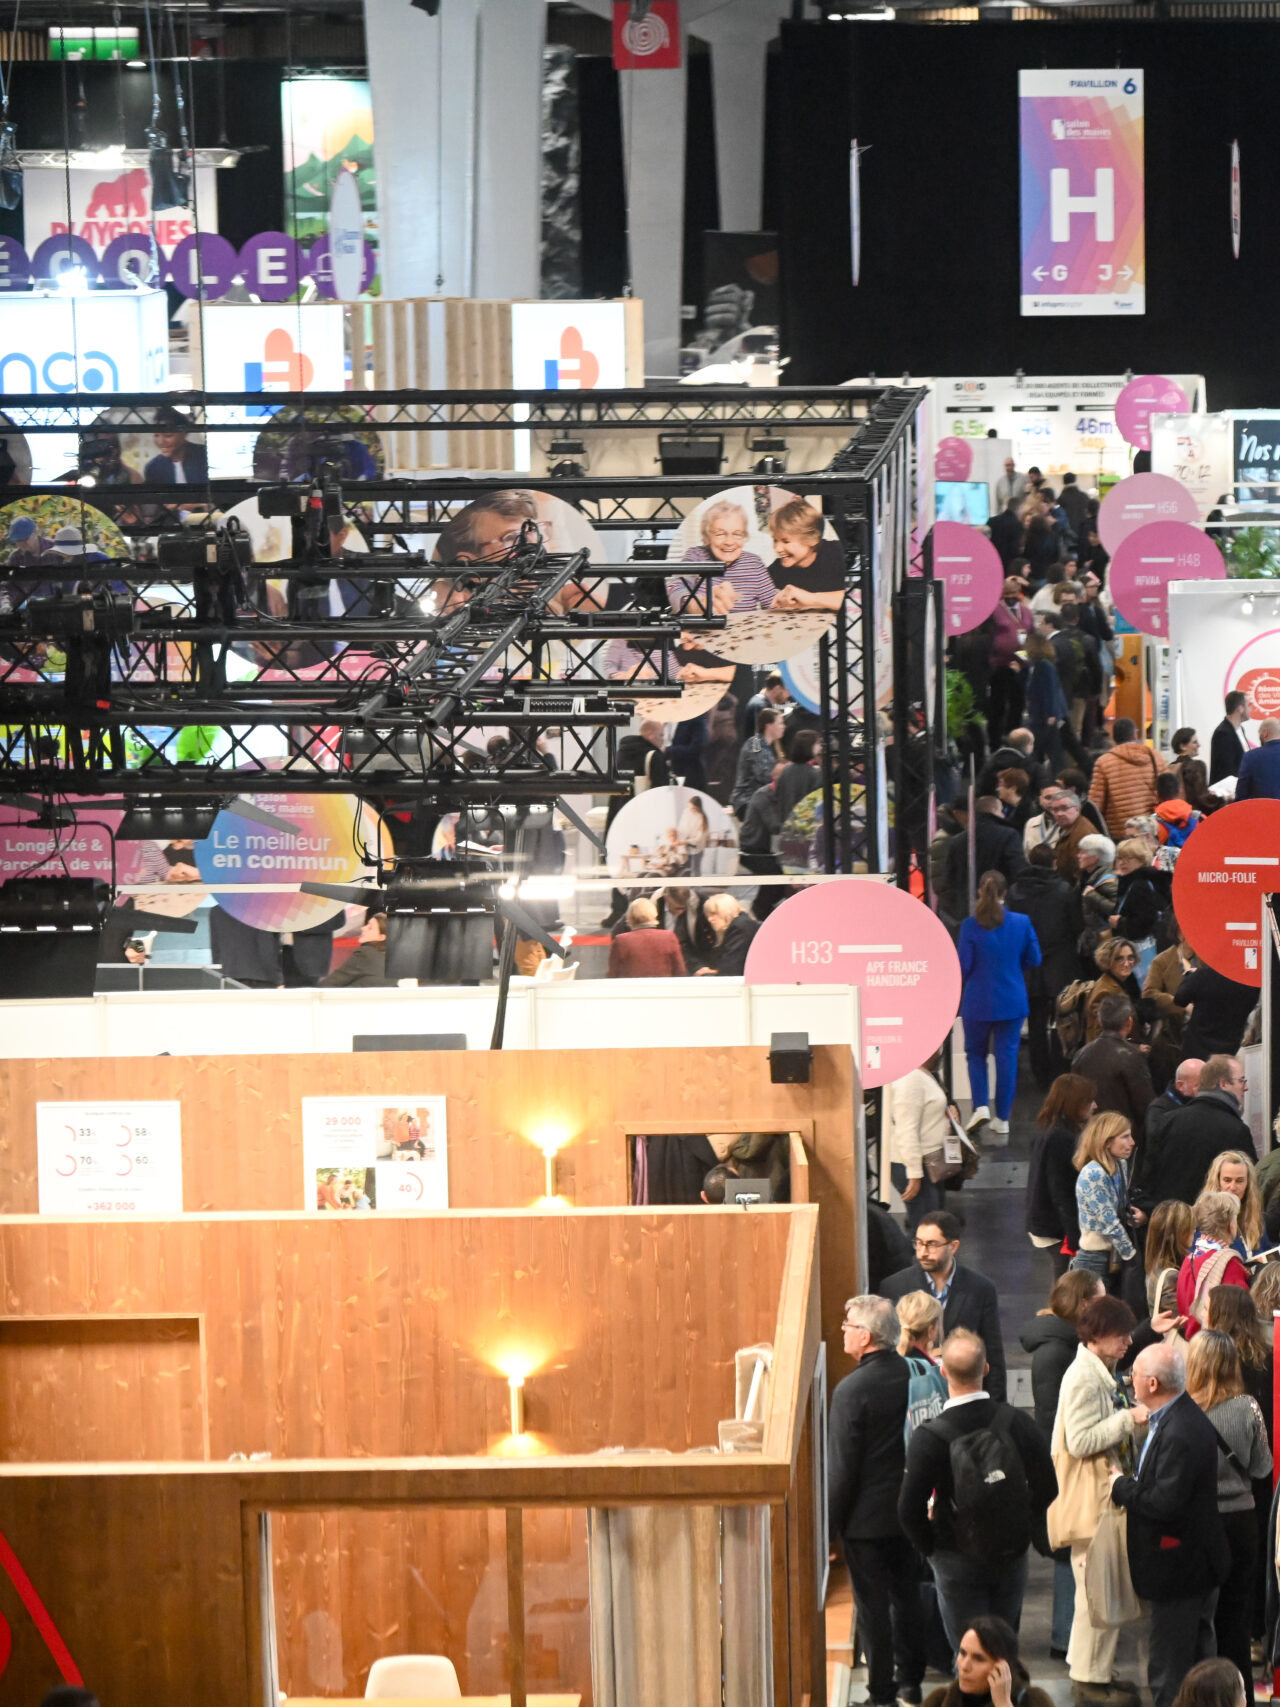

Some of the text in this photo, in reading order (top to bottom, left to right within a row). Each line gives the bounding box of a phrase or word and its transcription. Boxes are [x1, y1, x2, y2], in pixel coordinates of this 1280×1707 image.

[1069, 78, 1137, 95] PAVILLON 6
[1050, 167, 1115, 242] H
[1052, 264, 1113, 282] G J
[278, 803, 315, 814] maires
[6, 839, 103, 854] Longévité &
[213, 830, 332, 851] Le meilleur
[70, 857, 90, 871] de
[212, 853, 348, 872] en commun
[1198, 872, 1256, 884] MICRO-FOLIE
[1232, 938, 1258, 946] PAVILLON
[791, 940, 832, 964] H33
[866, 960, 928, 973] APF FRANCE
[866, 974, 920, 987] HANDICAP
